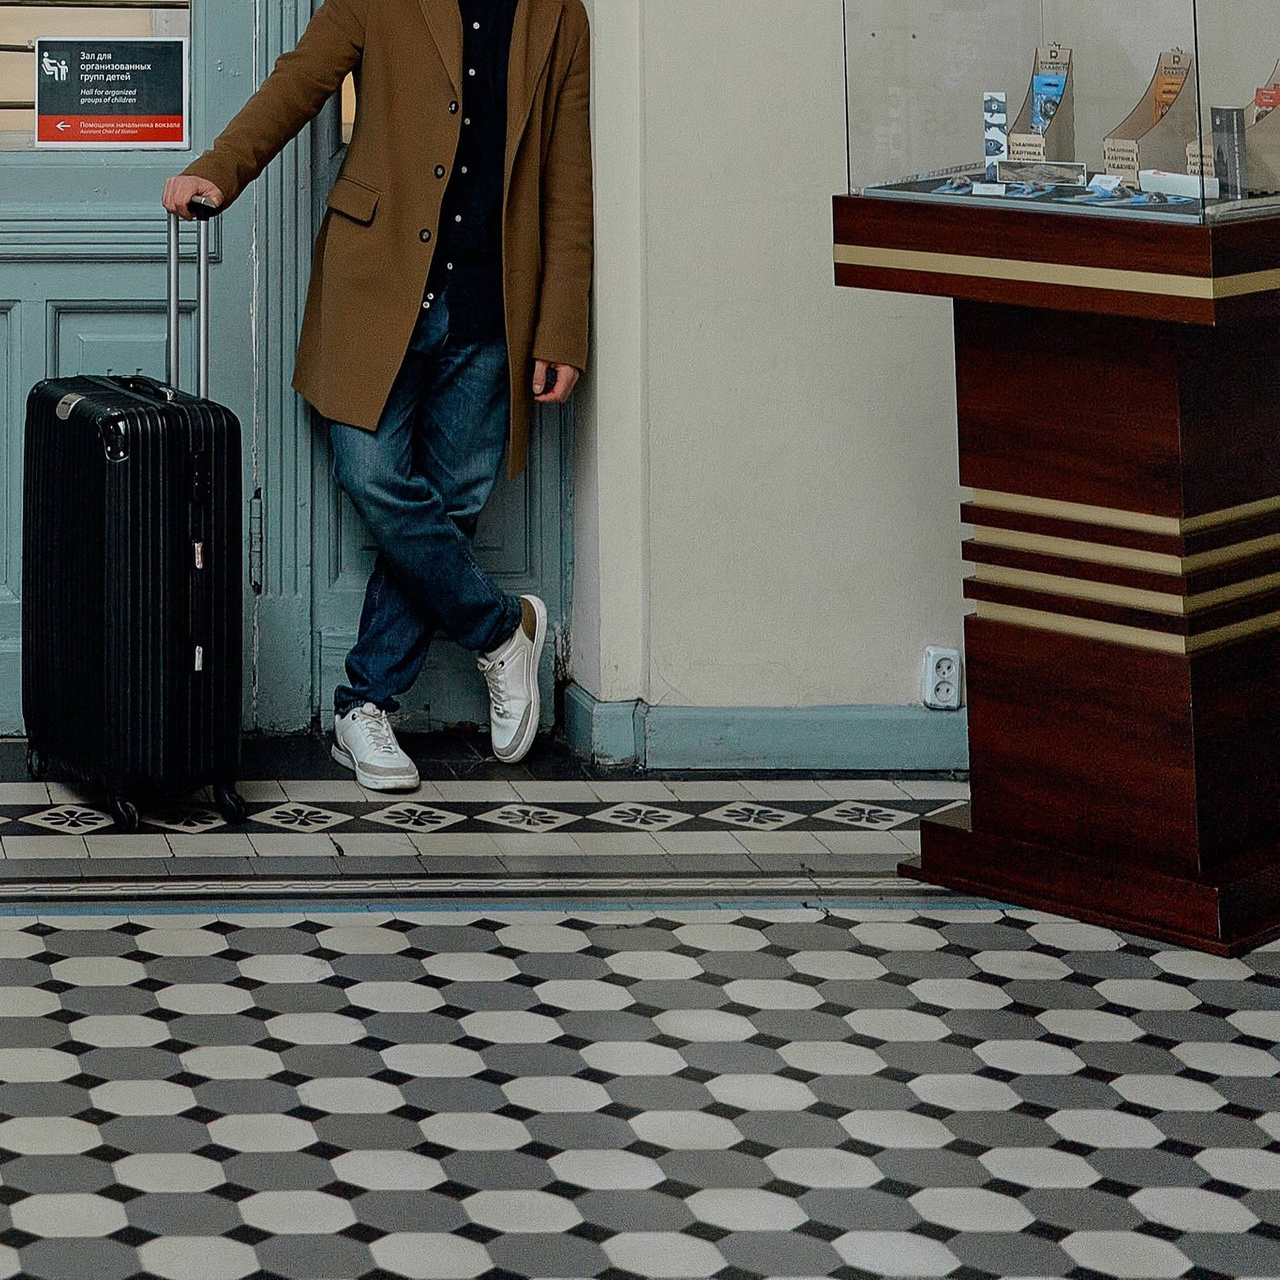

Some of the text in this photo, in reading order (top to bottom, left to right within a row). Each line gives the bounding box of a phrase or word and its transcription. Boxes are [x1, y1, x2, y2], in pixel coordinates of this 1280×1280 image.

[80, 52, 112, 61] Зал для
[80, 63, 152, 72] организованных
[80, 72, 131, 82] групп детей
[80, 88, 137, 98] Hall for organized
[103, 96, 111, 104] of
[111, 96, 136, 104] children
